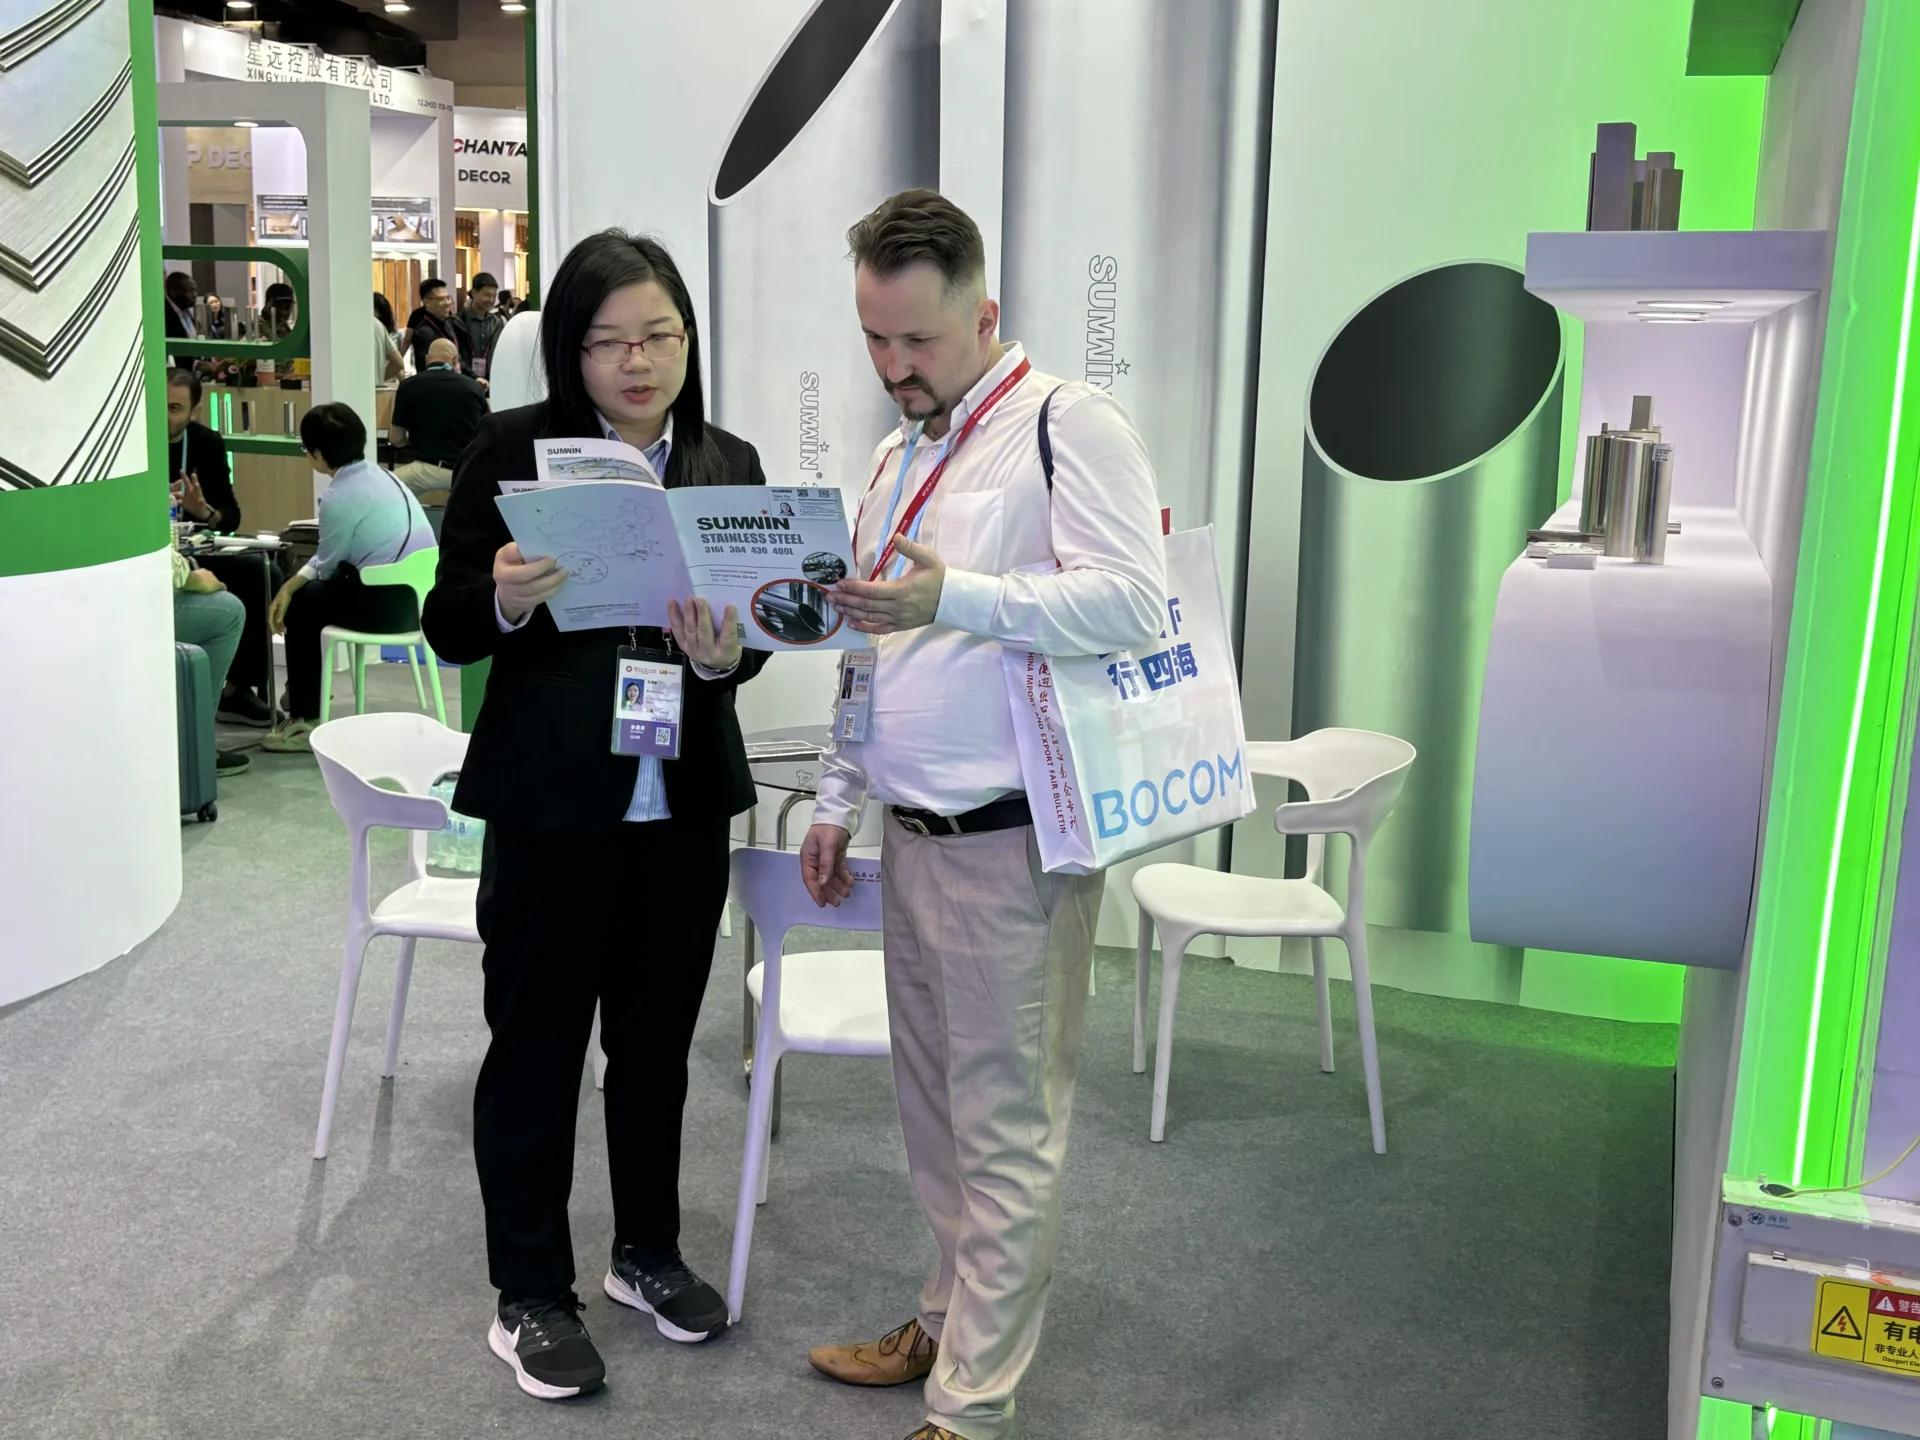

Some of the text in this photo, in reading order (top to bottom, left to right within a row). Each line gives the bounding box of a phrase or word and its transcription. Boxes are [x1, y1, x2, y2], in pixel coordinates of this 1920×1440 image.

[247, 41, 392, 92] 星远控股有限公司
[458, 169, 511, 184] DECOR
[800, 371, 819, 471] SUMWIN
[547, 447, 582, 455] SUMWIN
[697, 516, 790, 531] SUMWIN
[701, 532, 804, 545] STAINLESS STEEL
[751, 547, 768, 555] 430
[1107, 642, 1199, 700] 行四海
[1026, 674, 1036, 706] IMPORT
[1034, 711, 1044, 730] AND
[1040, 733, 1054, 767] EXPORT
[1049, 769, 1058, 789] FAIR
[1092, 747, 1243, 840] BOCOM
[1053, 792, 1067, 834] BULLETIN
[1898, 1299, 1920, 1314] 警告
